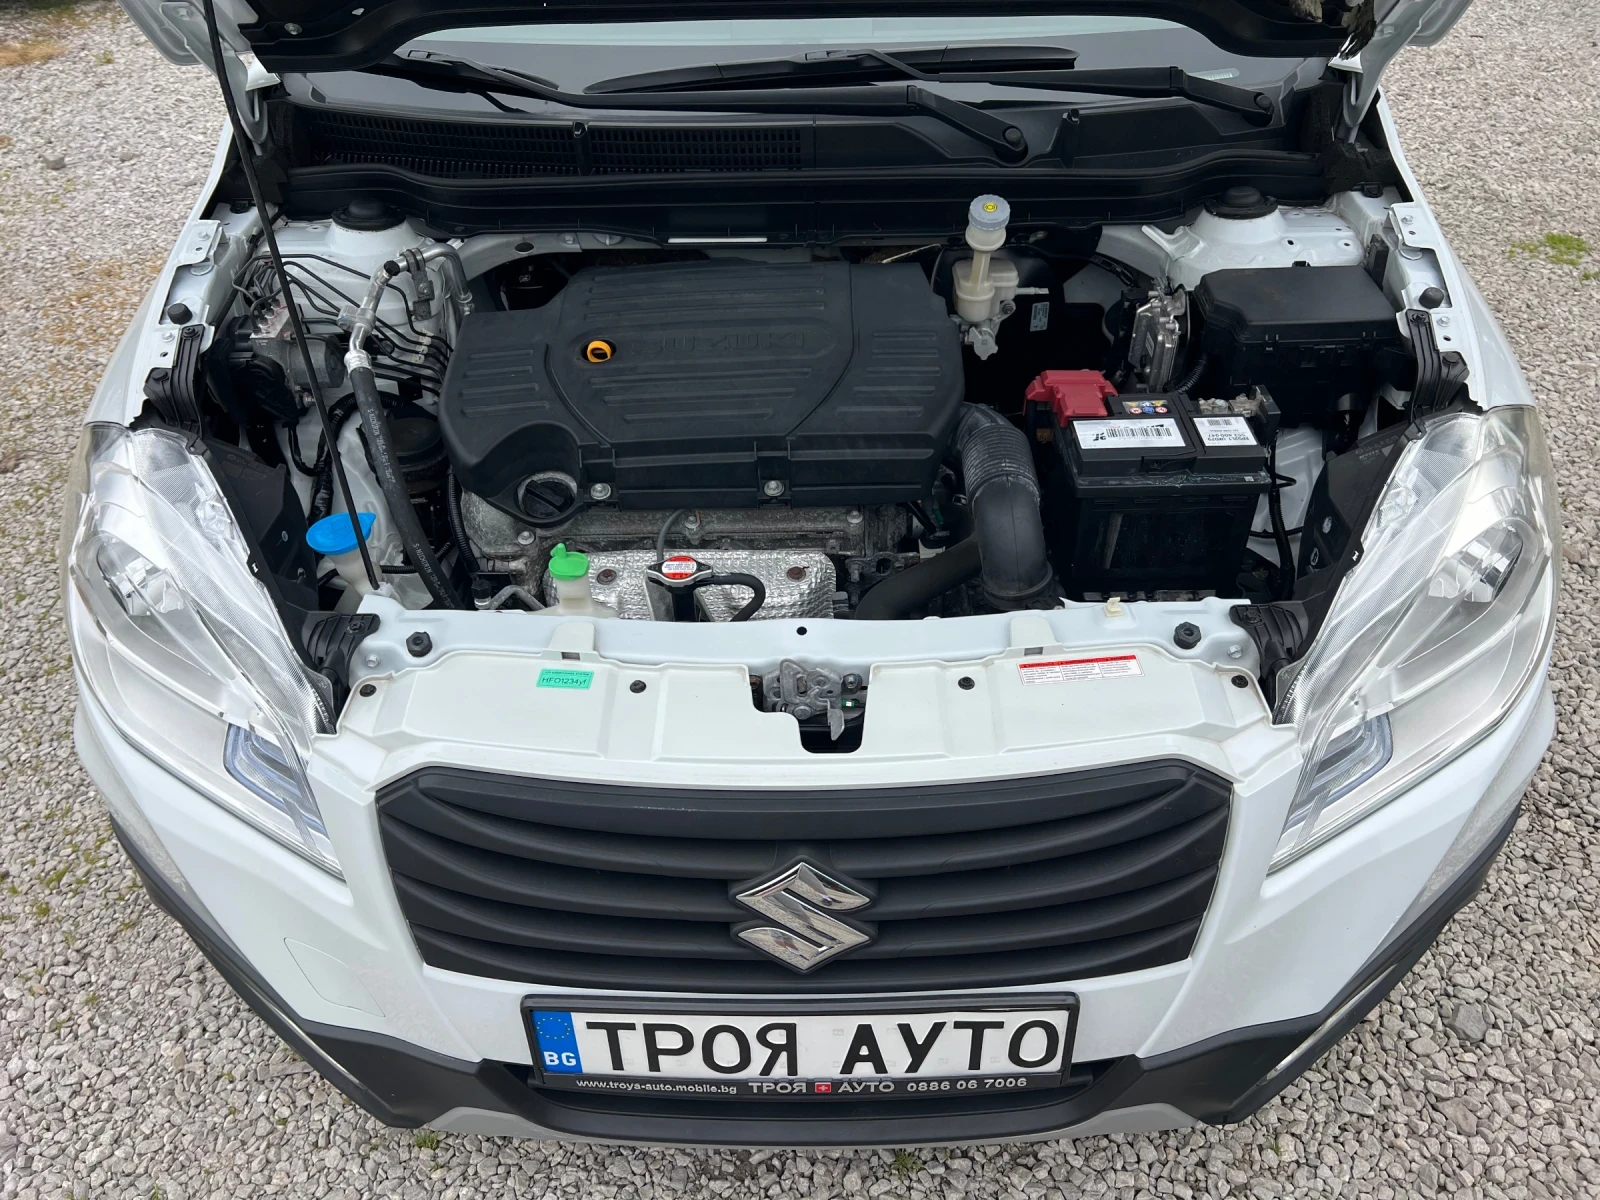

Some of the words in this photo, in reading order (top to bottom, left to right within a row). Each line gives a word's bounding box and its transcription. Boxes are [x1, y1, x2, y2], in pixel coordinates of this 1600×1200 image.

[541, 676, 588, 686] HFO1234yf
[586, 1020, 798, 1077] ТРОЯ
[840, 1019, 1059, 1075] АУТО
[543, 1050, 578, 1068] BG
[576, 1079, 737, 1095] www.troya-auto.mobile.bg
[748, 1082, 807, 1094] ТРОЯ
[837, 1081, 895, 1093] АУТО
[906, 1081, 951, 1092] 0886
[956, 1080, 978, 1090] 06
[984, 1077, 1028, 1089] 7006
